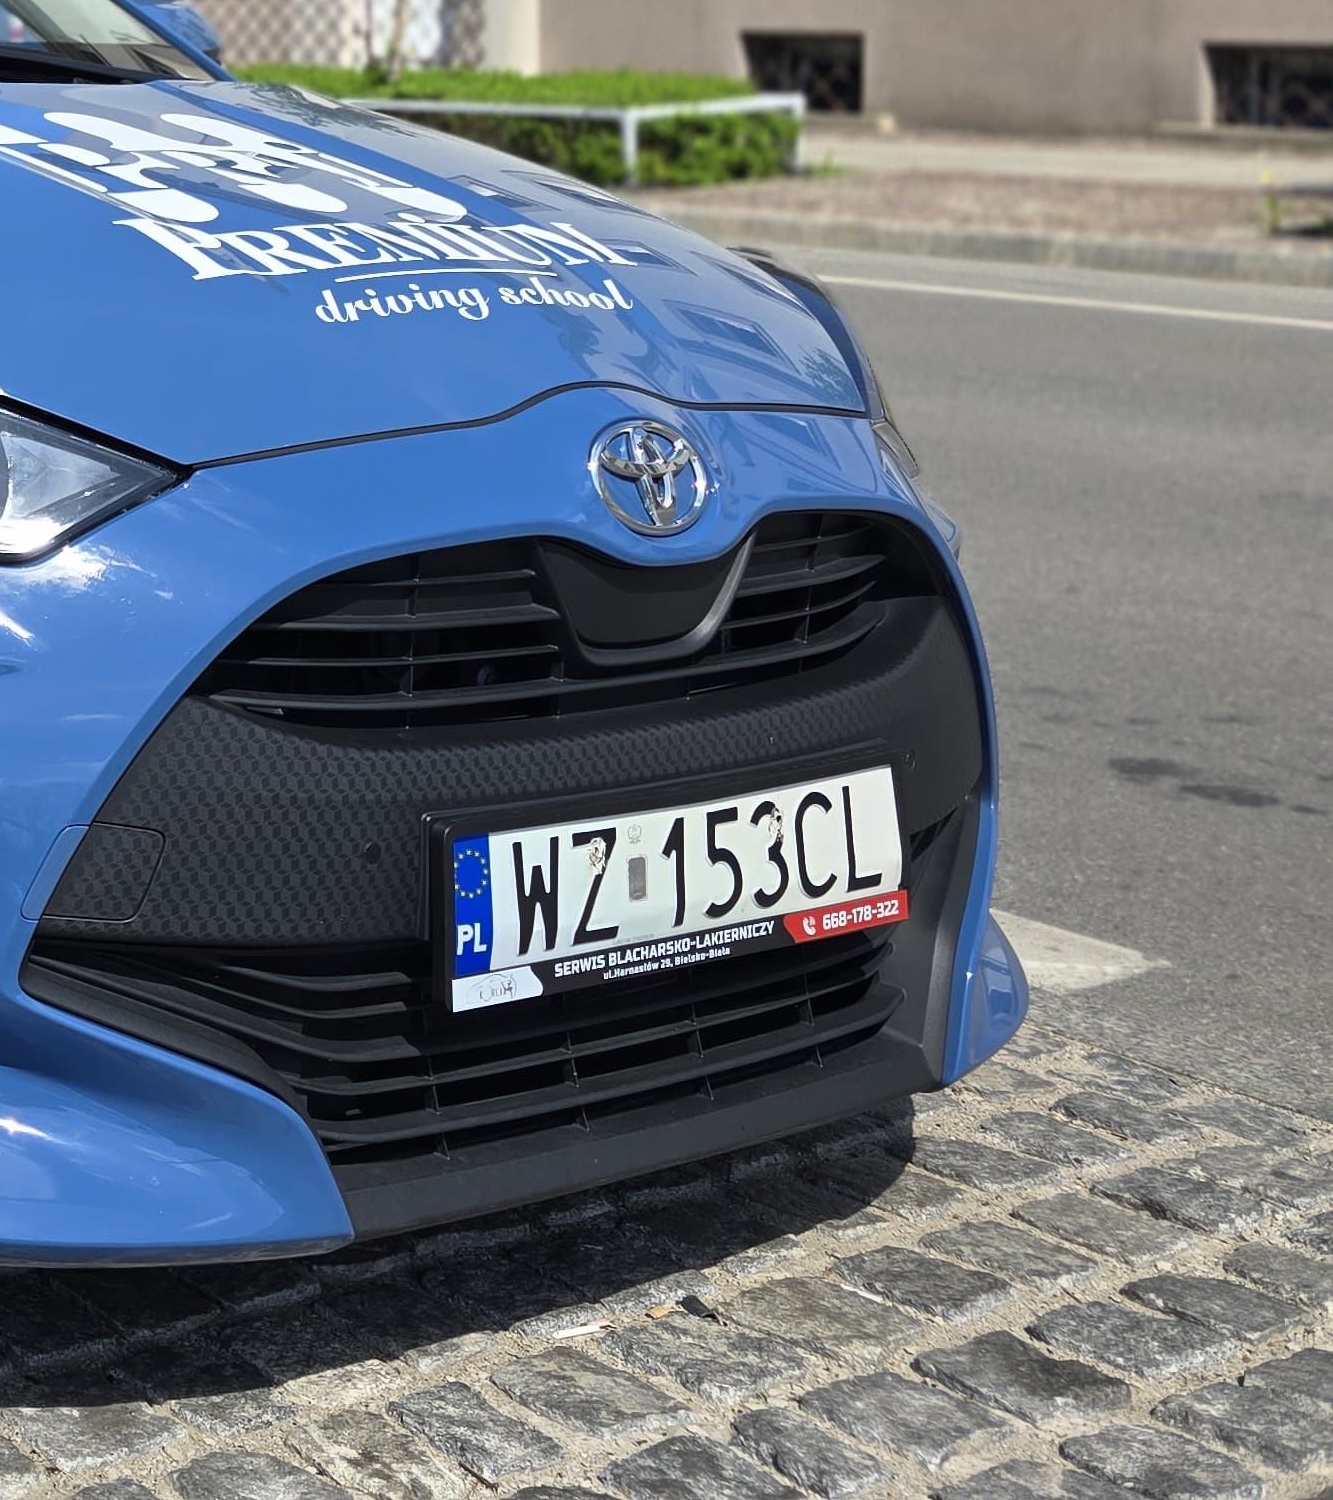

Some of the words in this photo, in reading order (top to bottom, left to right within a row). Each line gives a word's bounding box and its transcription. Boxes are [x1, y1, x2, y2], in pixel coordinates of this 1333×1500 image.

[315, 283, 490, 323] driving
[496, 277, 634, 311] school
[511, 827, 620, 956] WZ
[661, 786, 883, 927] 153CL
[822, 899, 900, 930] 668-178-322
[456, 922, 487, 956] PL
[554, 954, 606, 978] SERWIS
[608, 920, 775, 967] BLACHARSKO-LAKIERNICZY
[674, 946, 731, 966] Bielsko-Biała
